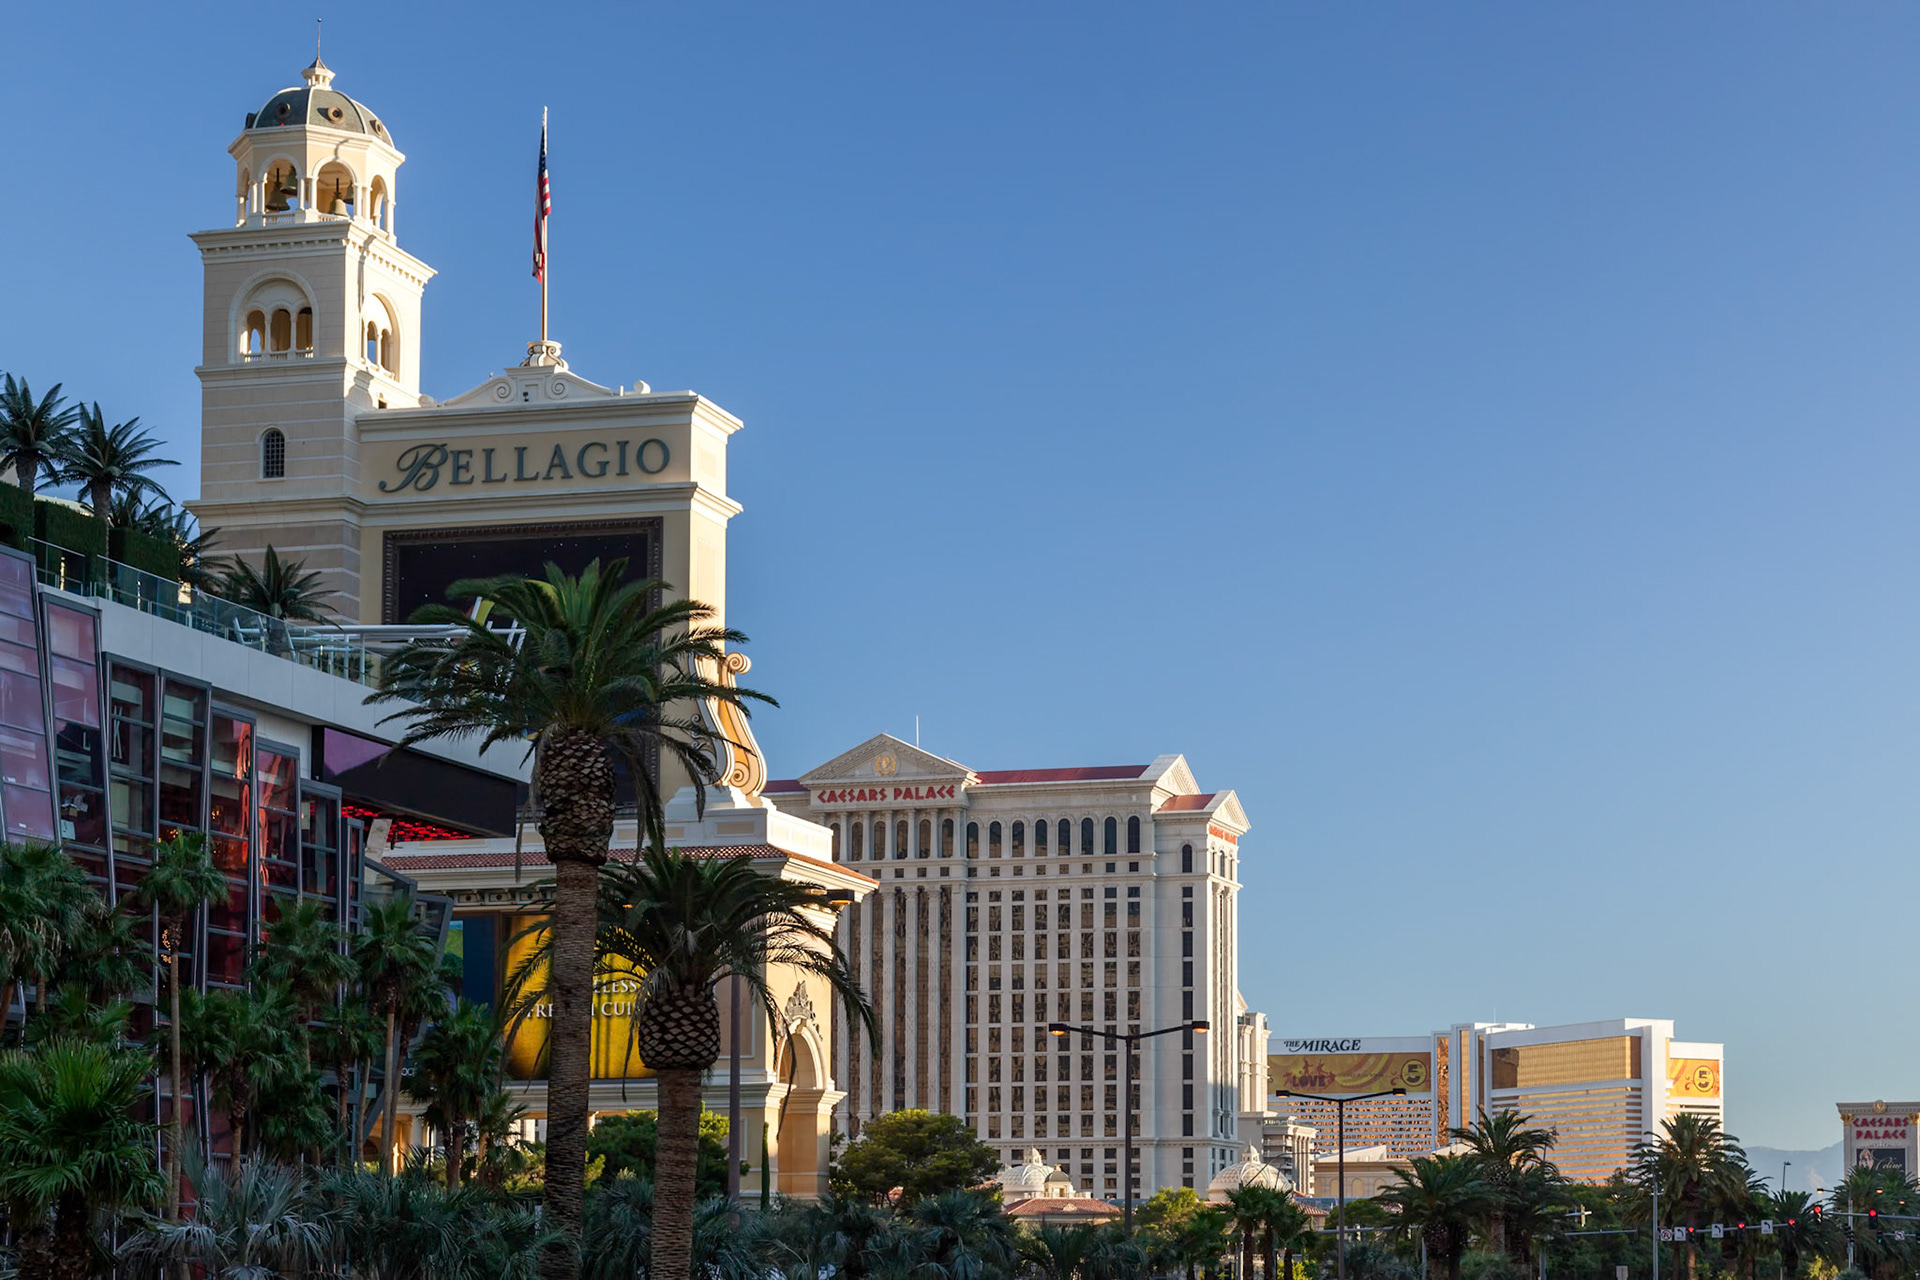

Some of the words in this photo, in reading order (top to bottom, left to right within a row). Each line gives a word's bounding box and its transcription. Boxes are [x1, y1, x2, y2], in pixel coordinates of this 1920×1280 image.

[378, 438, 671, 493] BELLAGIO
[817, 787, 887, 803] CAESARS
[893, 784, 955, 801] PALACE
[1284, 1040, 1300, 1048] THE
[1288, 1039, 1361, 1053] MIRAGE
[1853, 1117, 1908, 1127] CAESARS
[1856, 1130, 1906, 1139] PALACE
